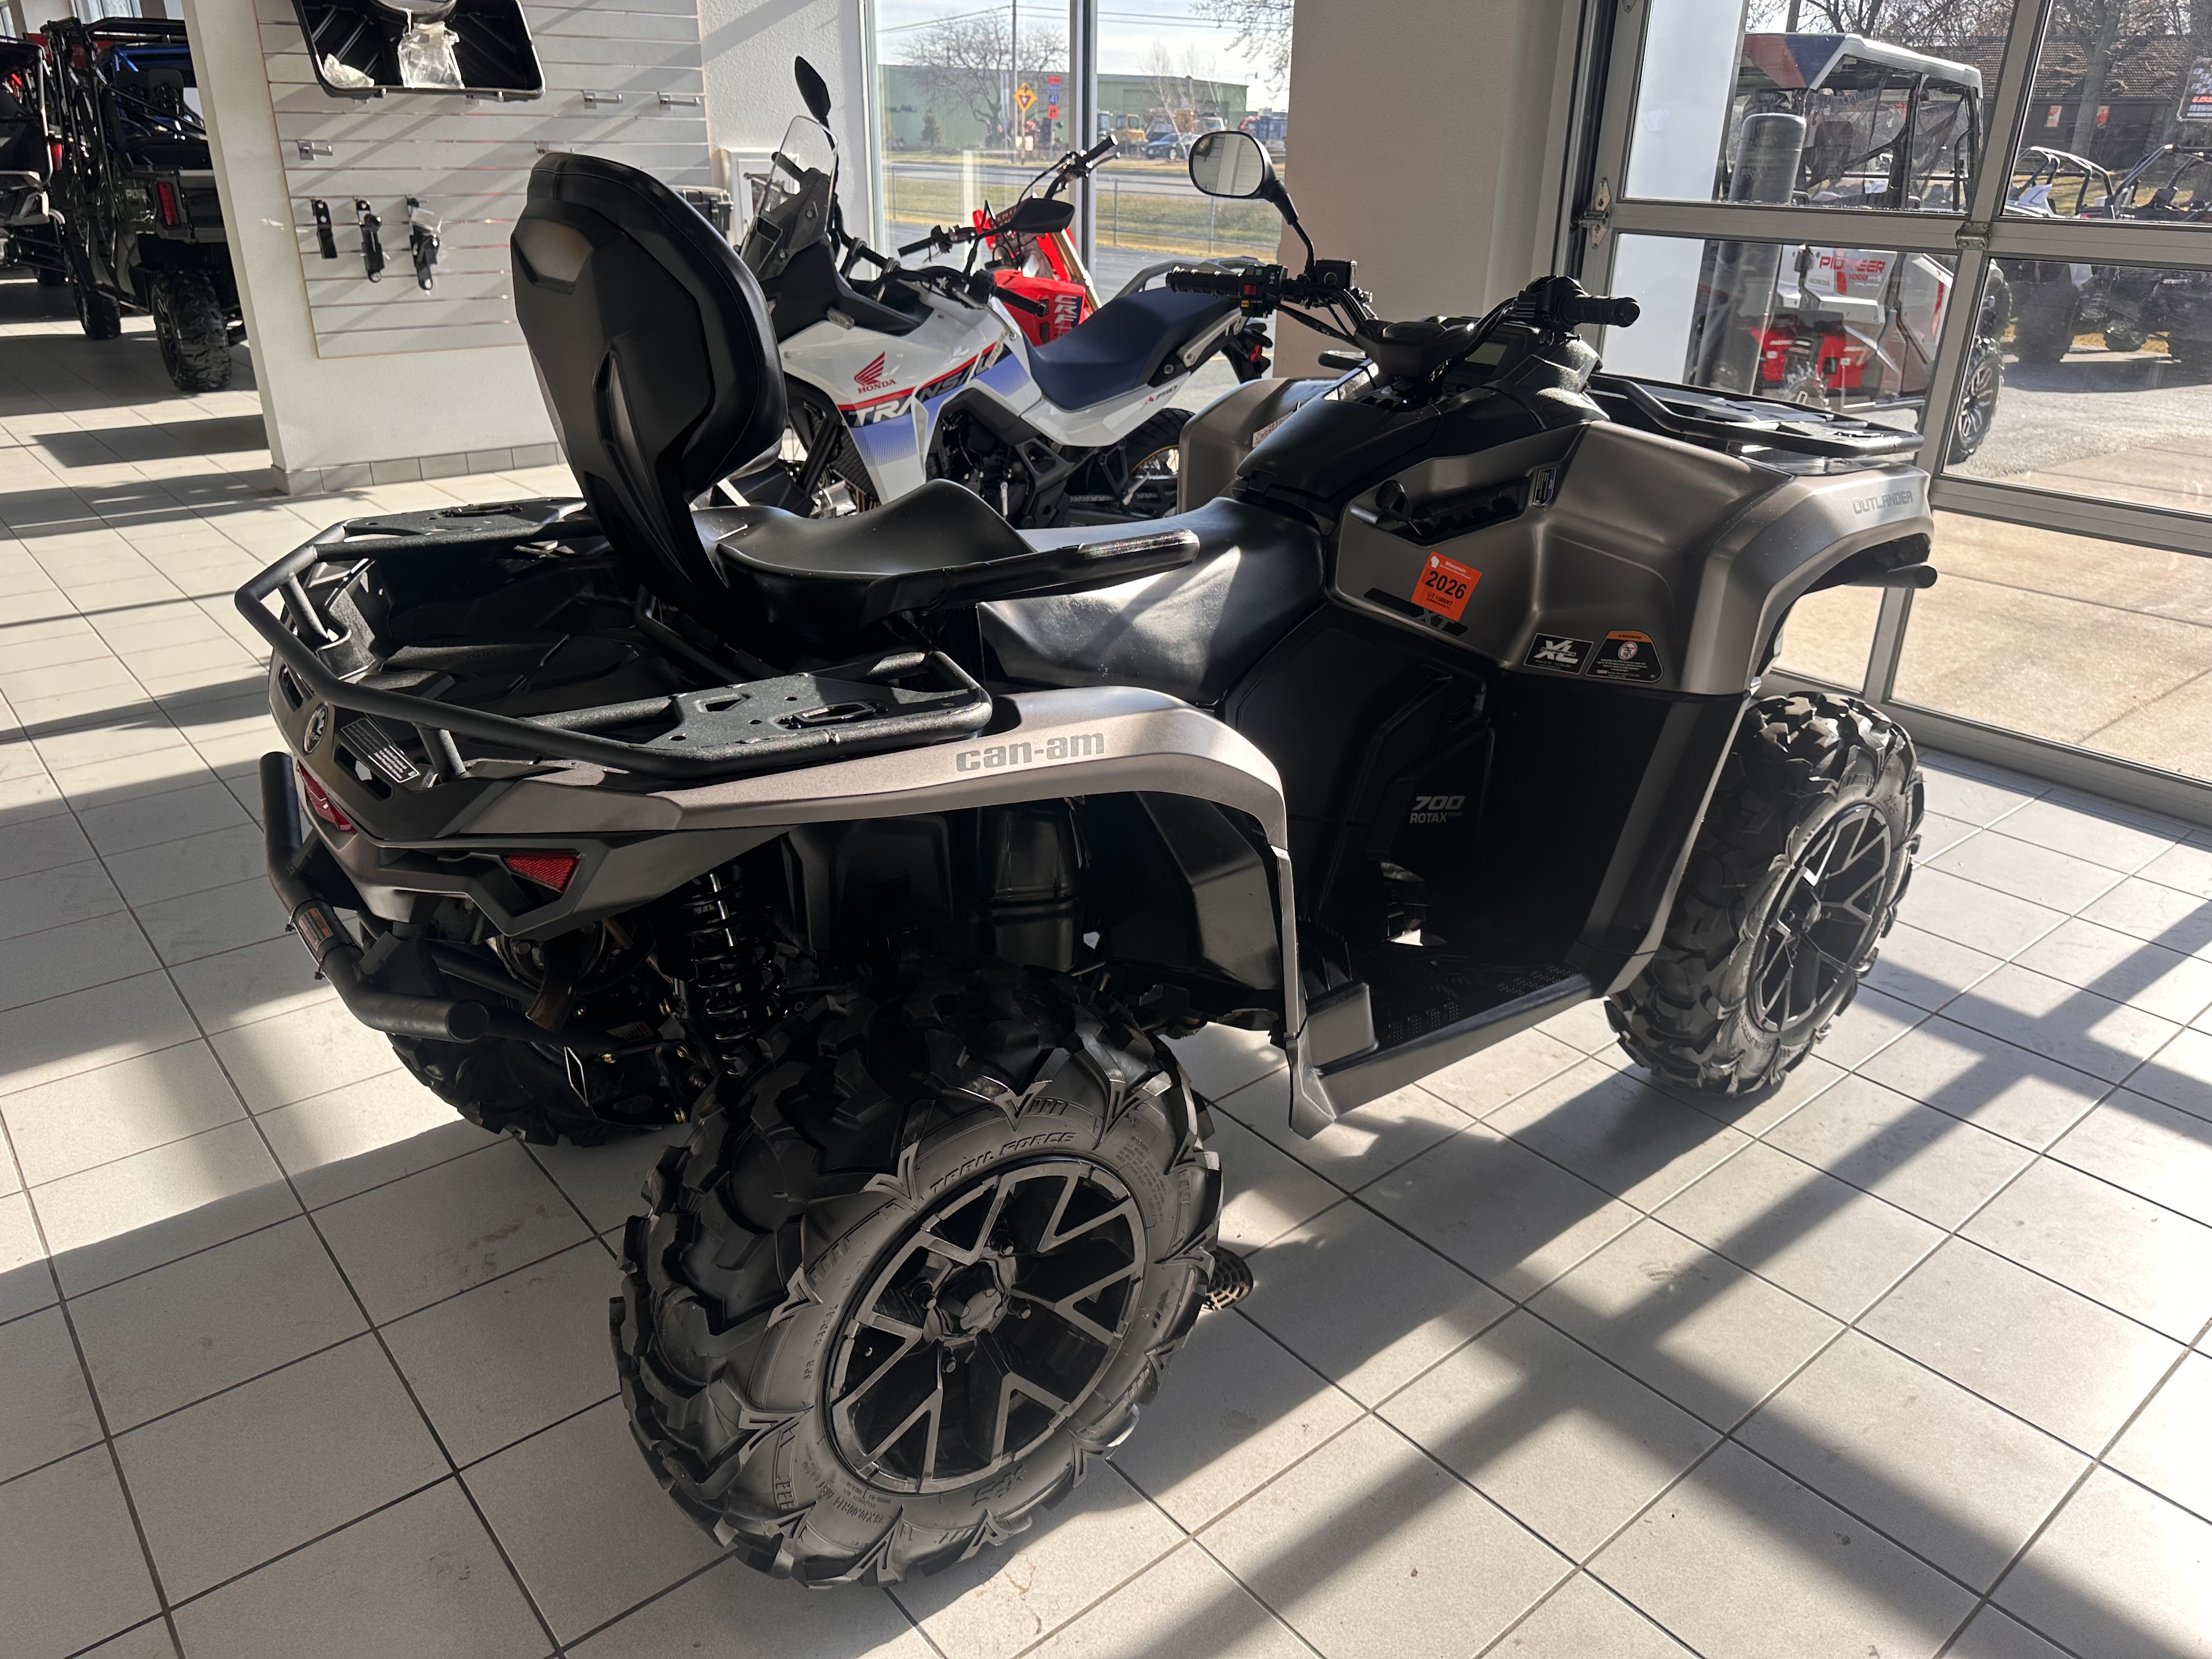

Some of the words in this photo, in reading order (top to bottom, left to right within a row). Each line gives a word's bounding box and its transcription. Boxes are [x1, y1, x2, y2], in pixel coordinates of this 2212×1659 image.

[1819, 256, 1886, 273] PIONEER
[857, 379, 898, 394] HONDA
[1852, 490, 1914, 515] OUTLANDER
[1445, 561, 1466, 573] Wisconsin
[1425, 571, 1467, 599] 2026
[1414, 607, 1455, 629] XT
[956, 732, 1105, 772] can-am
[1412, 795, 1466, 811] 700
[1409, 812, 1447, 823] ROTAX
[930, 1150, 995, 1194] TRAIL
[999, 1132, 1077, 1156] FORCE
